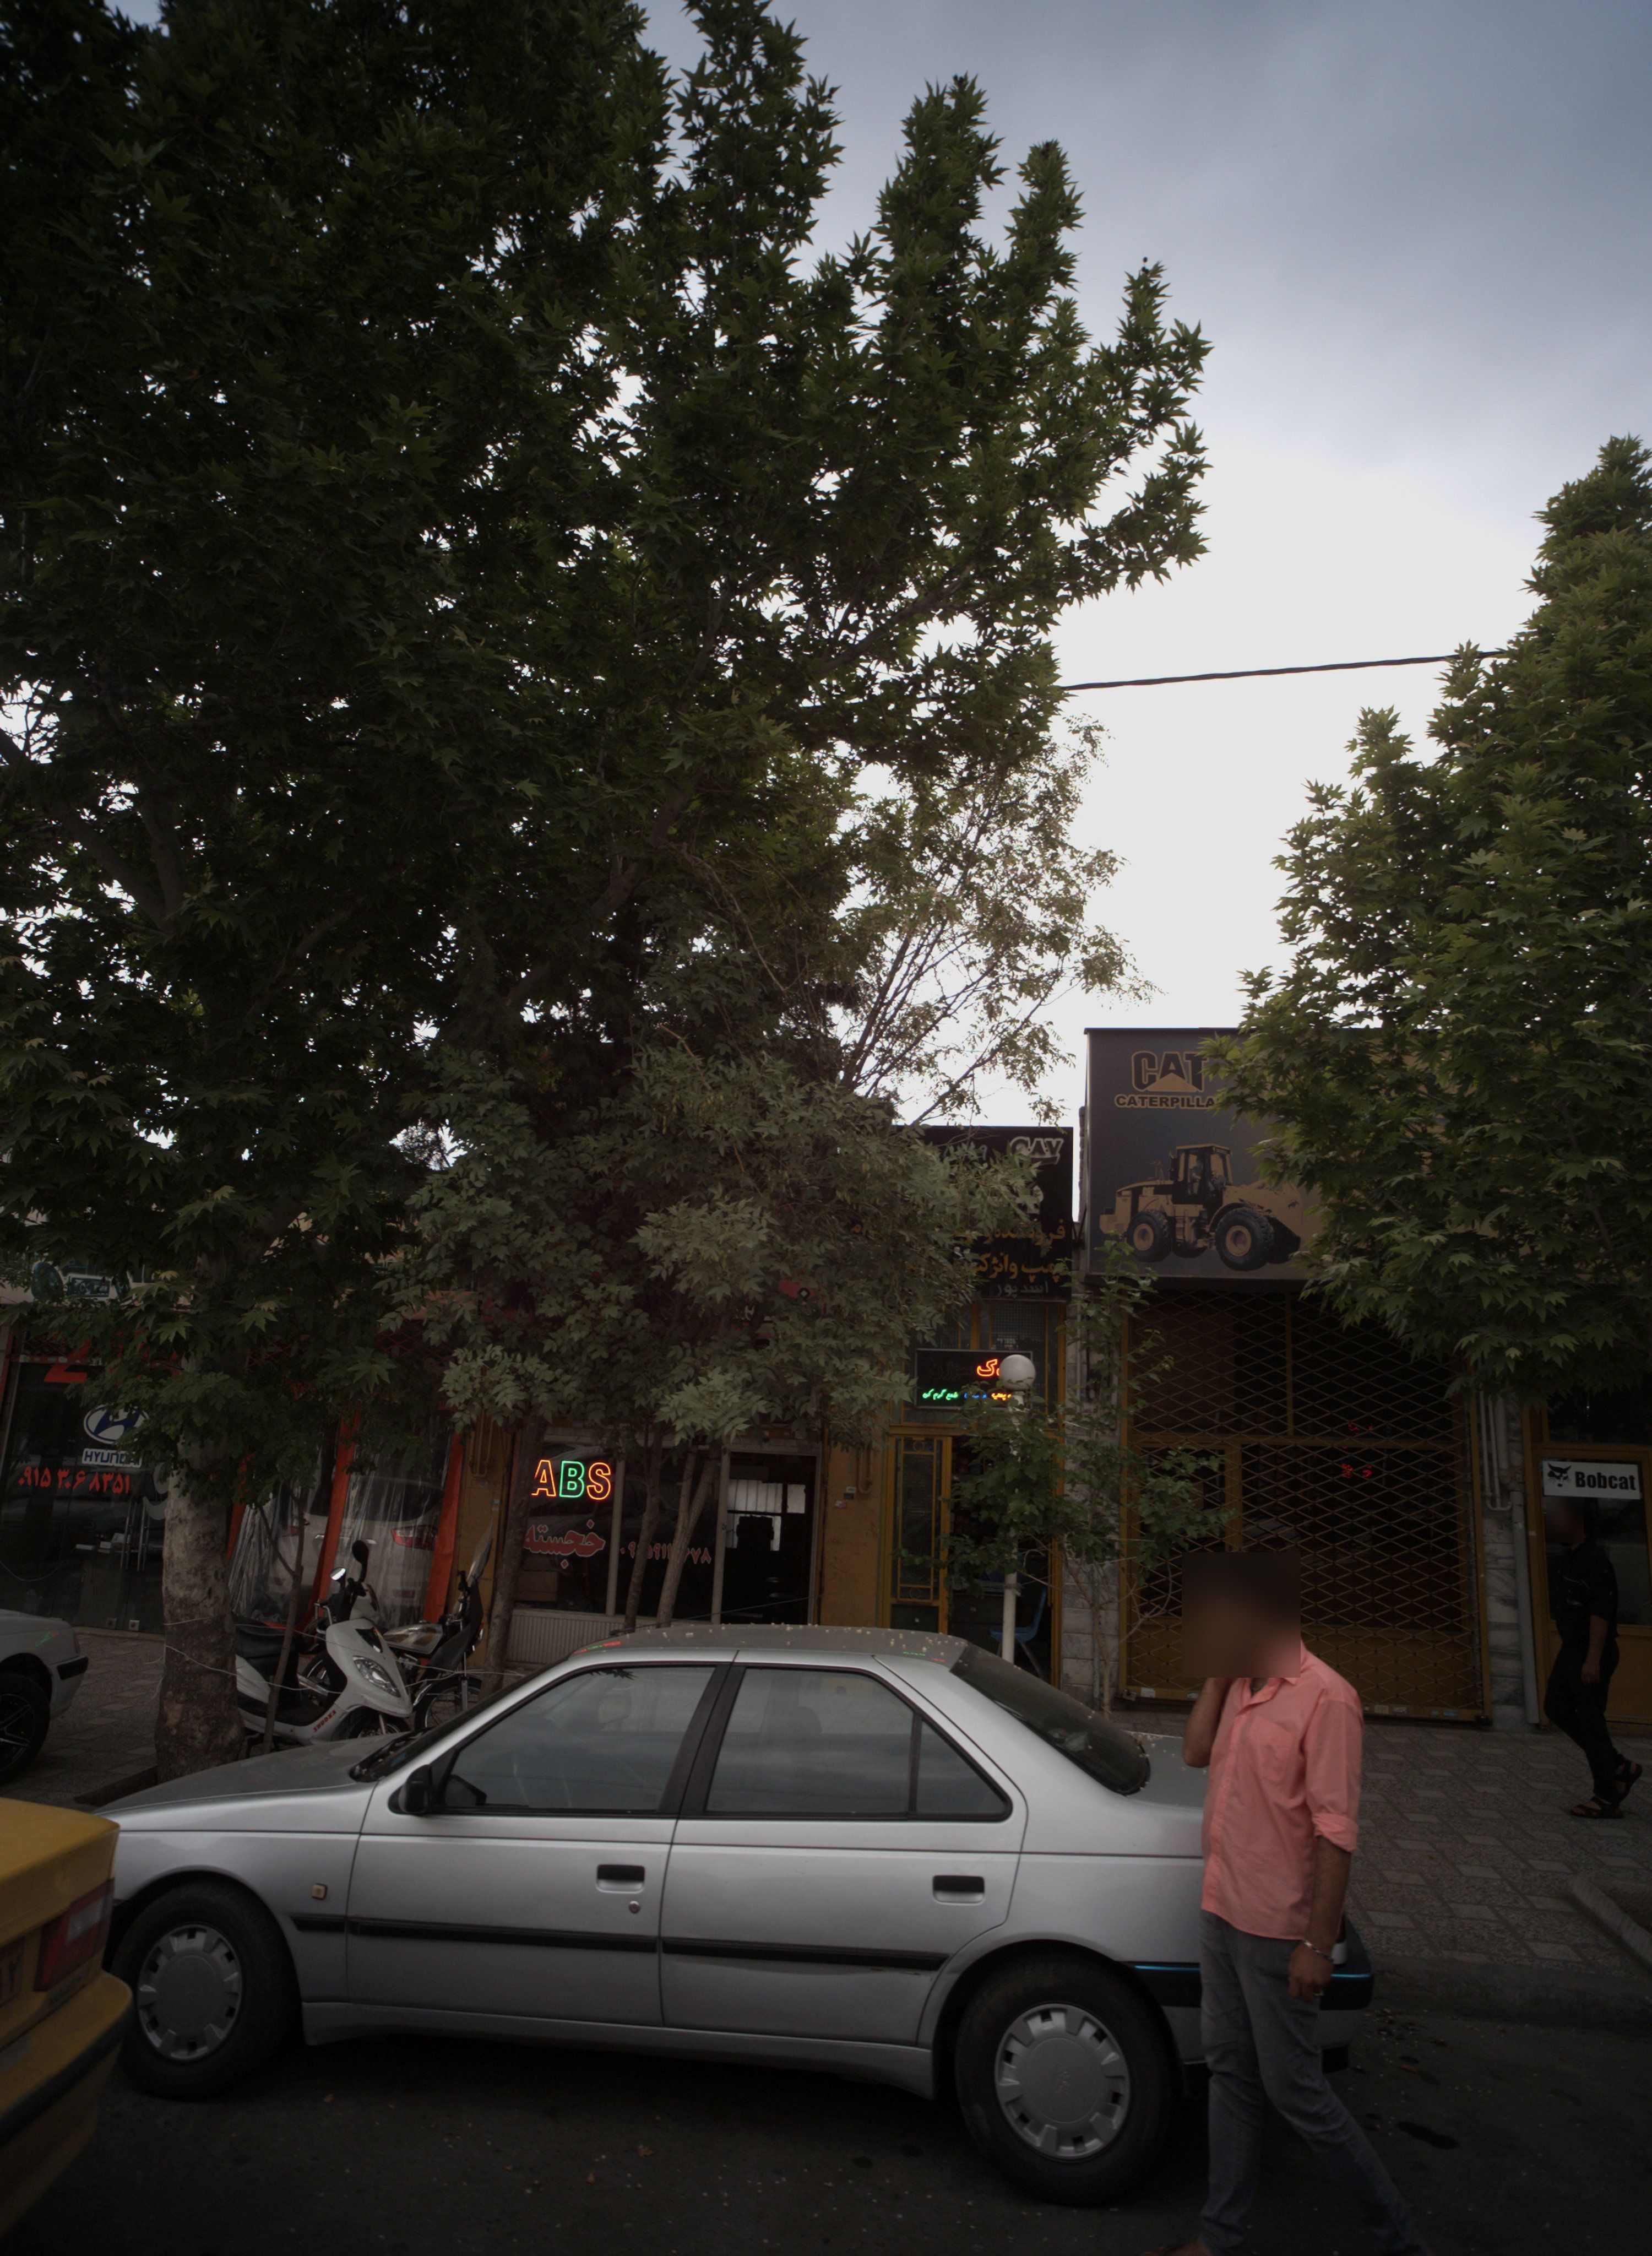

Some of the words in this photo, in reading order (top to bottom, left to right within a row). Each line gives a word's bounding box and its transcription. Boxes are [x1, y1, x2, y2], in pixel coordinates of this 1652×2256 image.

[1132, 1050, 1208, 1092] CAT
[1115, 1093, 1215, 1109] CATERPILLA
[84, 1450, 140, 1466] HYUND
[531, 1459, 612, 1501] ABS
[1575, 1471, 1636, 1490] Bobcat
[524, 1519, 606, 1569] خجسته
